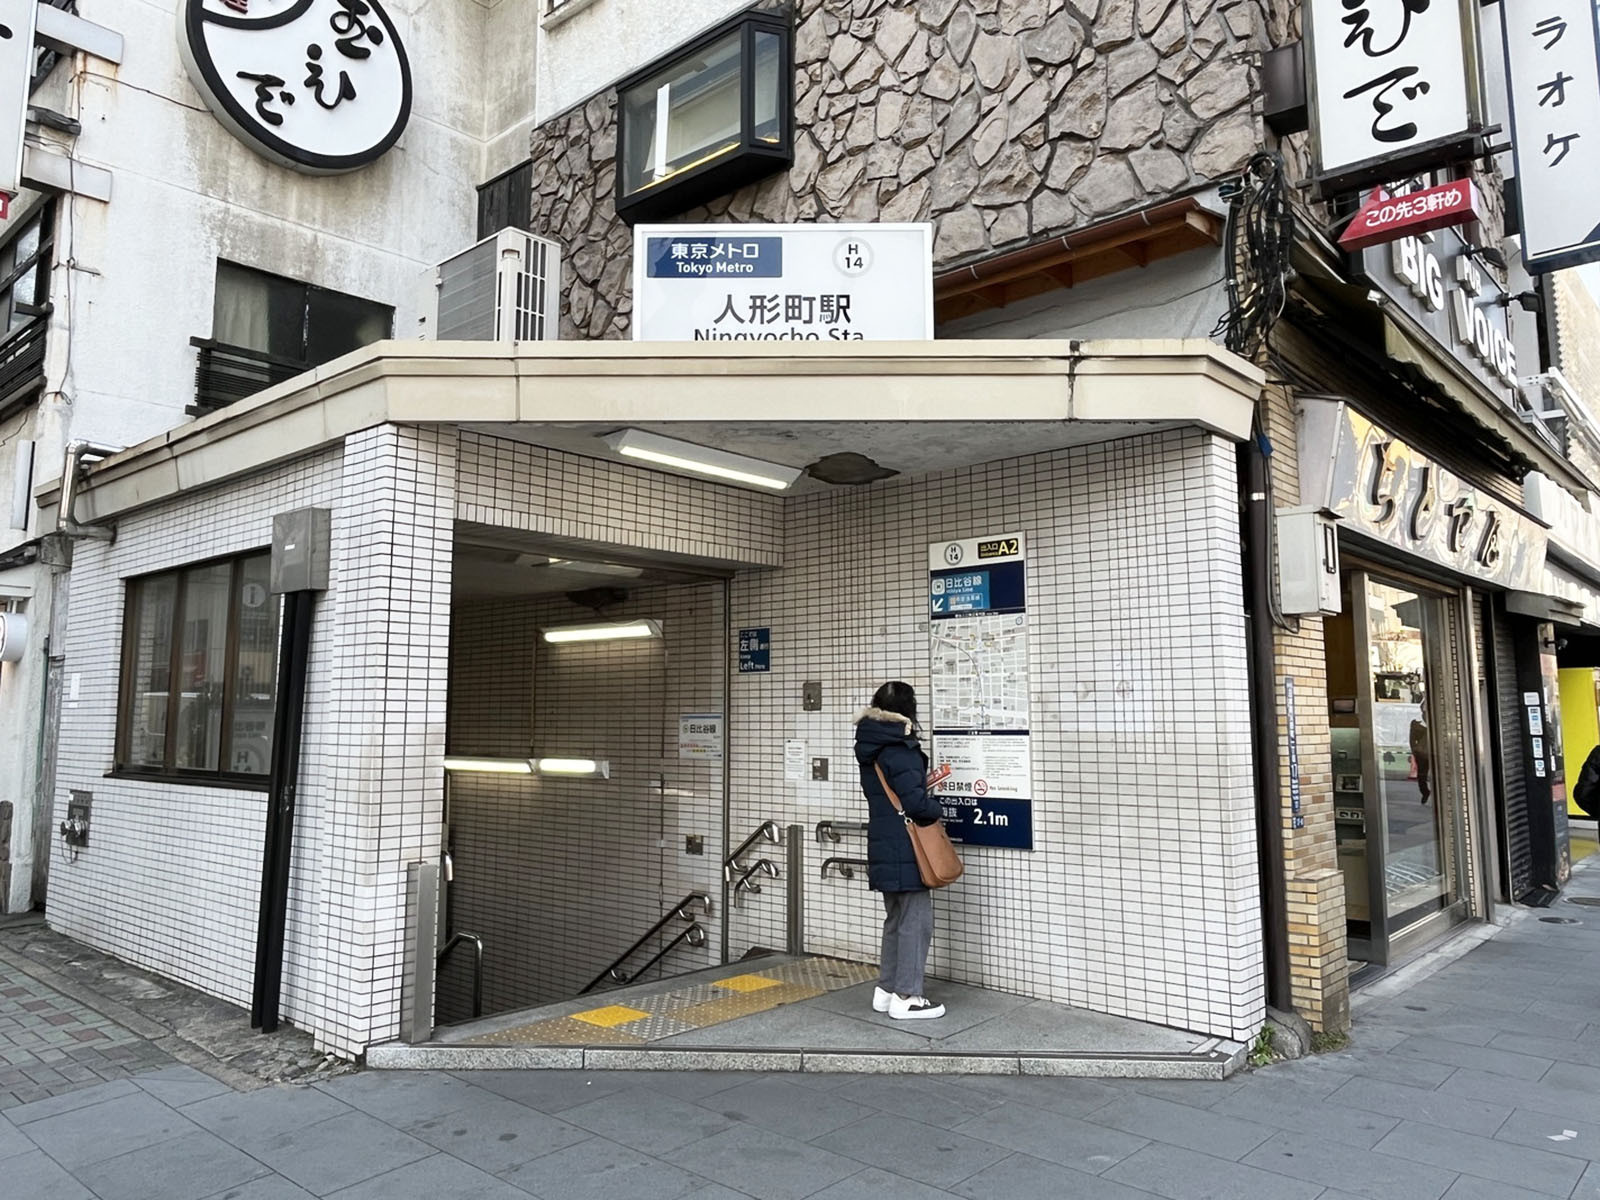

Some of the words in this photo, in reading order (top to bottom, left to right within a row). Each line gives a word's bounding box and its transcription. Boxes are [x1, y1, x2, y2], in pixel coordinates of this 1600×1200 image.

[1531, 15, 1581, 168] ラオケ
[1365, 188, 1462, 228] この先3軒め
[670, 243, 760, 260] 東京メトロ
[848, 244, 858, 255] H
[676, 261, 713, 275] Tokyo
[716, 261, 754, 274] Metro
[844, 257, 864, 269] 14
[1397, 235, 1444, 311] BIG
[713, 294, 851, 325] 人形町駅
[1458, 287, 1518, 388] VOICE
[998, 539, 1018, 556] A2
[740, 661, 754, 670] Left
[973, 808, 1009, 827] 2.1m
